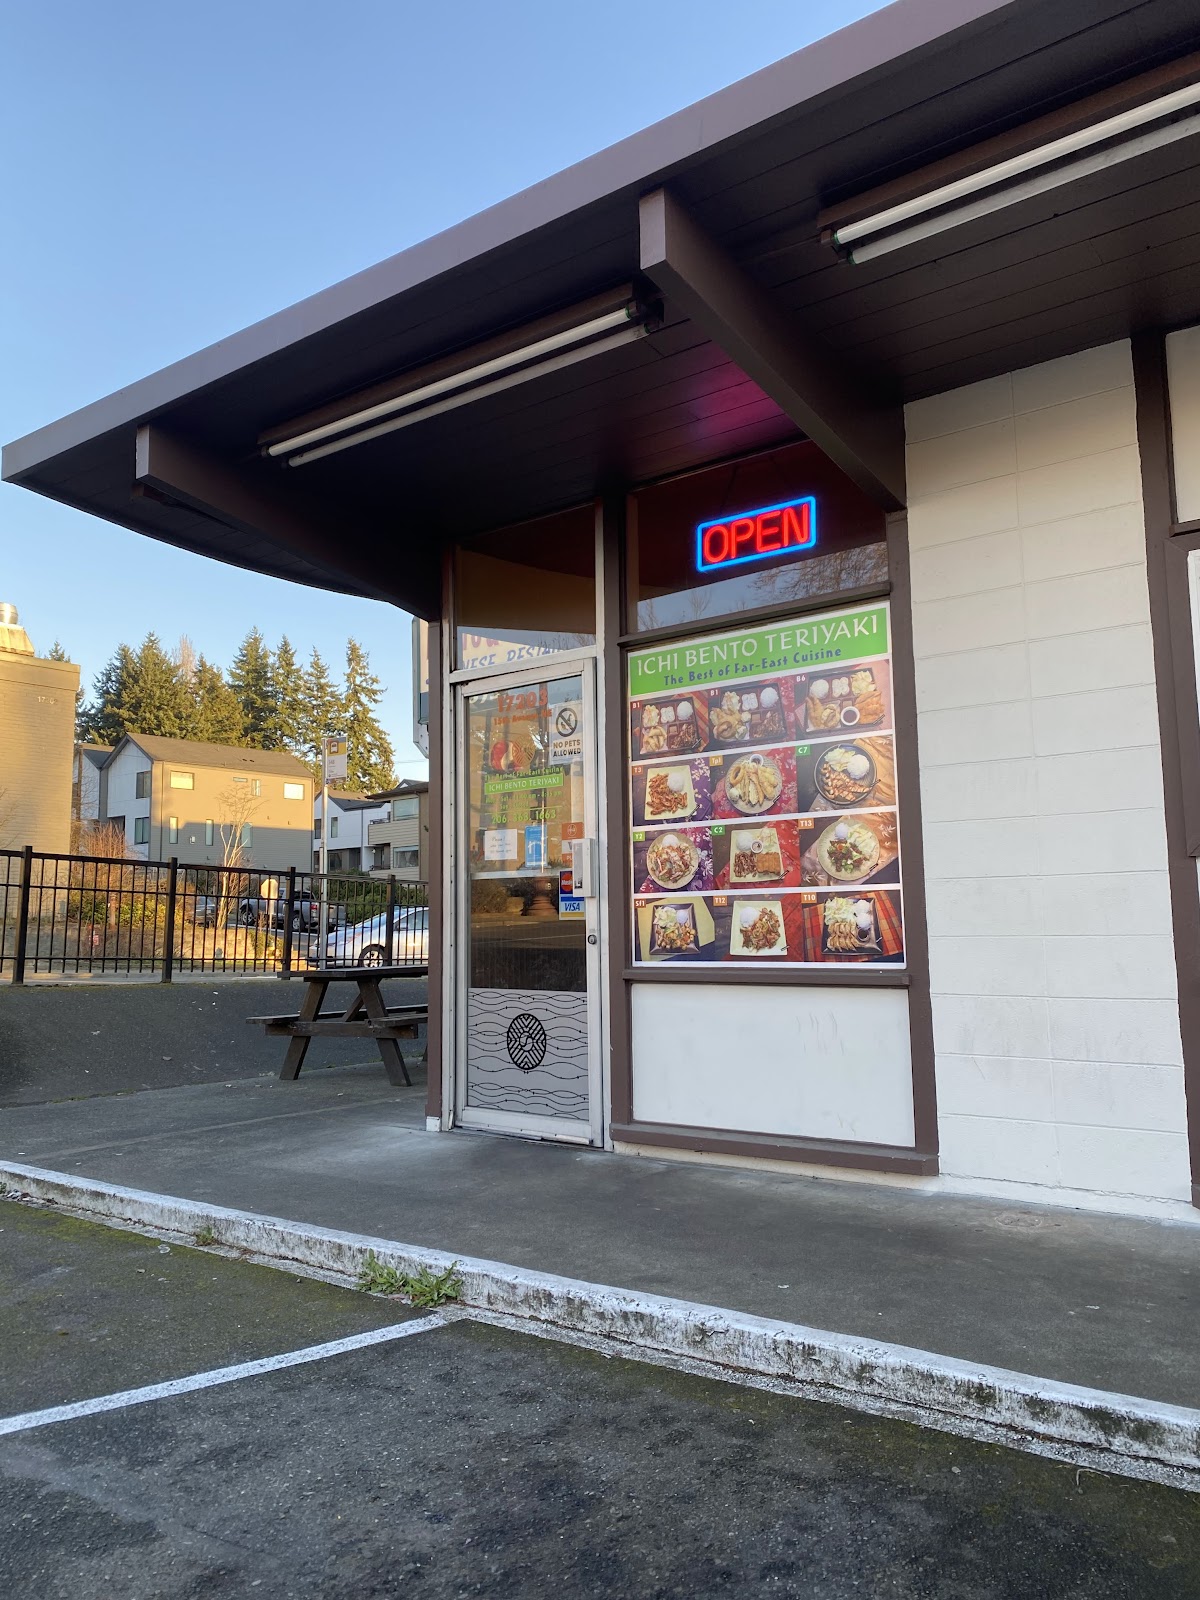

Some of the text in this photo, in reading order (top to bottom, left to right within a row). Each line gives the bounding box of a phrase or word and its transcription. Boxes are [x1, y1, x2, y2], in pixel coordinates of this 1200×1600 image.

[703, 503, 810, 563] OPEN
[637, 615, 877, 676] ICHI BENTO TERIYAKI
[664, 648, 842, 686] The Best of Far-East Cuisine
[796, 674, 806, 682] B6
[498, 688, 548, 712] 17203
[552, 748, 582, 758] ALLOWED
[489, 776, 560, 792] ICHI BENTO TERIYAKI
[800, 820, 813, 828] T13
[564, 902, 580, 911] VISA
